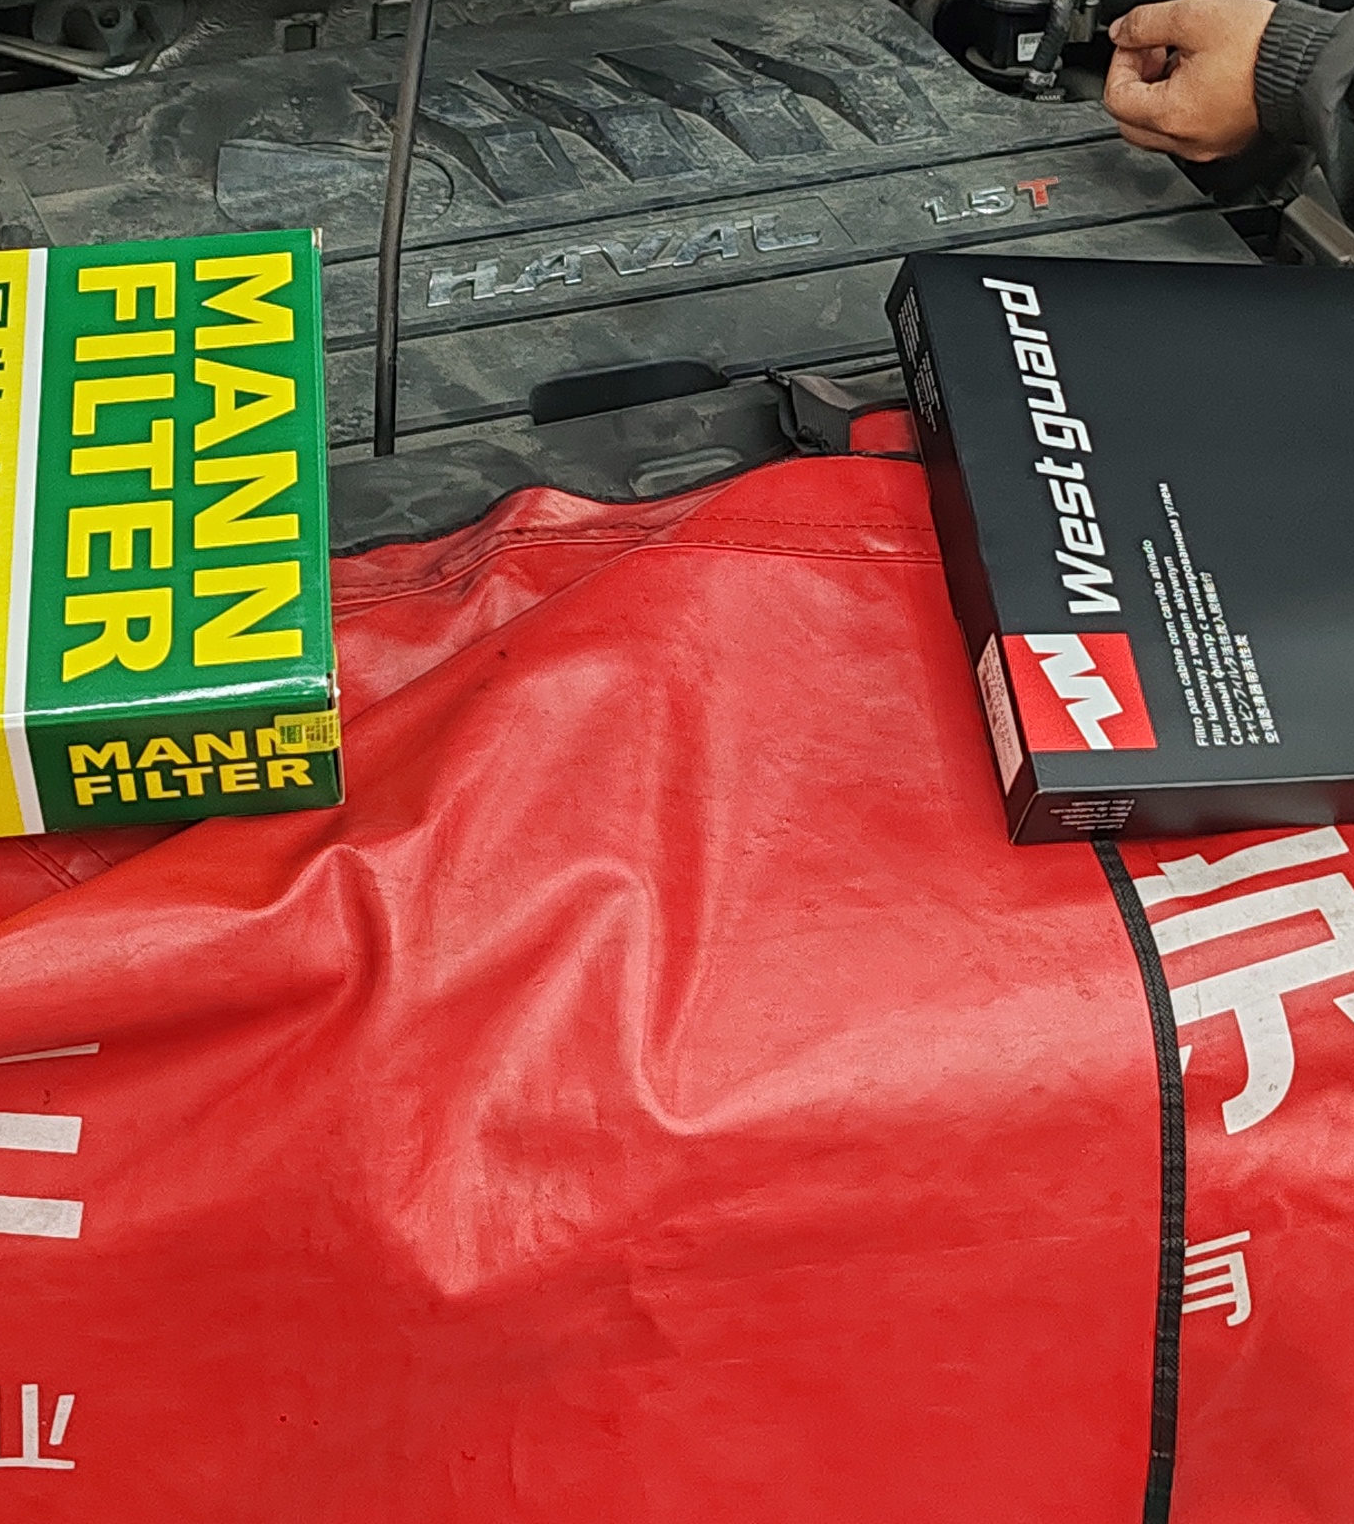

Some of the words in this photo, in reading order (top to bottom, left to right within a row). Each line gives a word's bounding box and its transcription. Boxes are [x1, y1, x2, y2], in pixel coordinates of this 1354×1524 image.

[427, 214, 822, 307] HAVAL
[62, 261, 176, 683] FILTER
[194, 251, 303, 667] MANN
[1158, 483, 1180, 518] углем
[1142, 539, 1162, 580] ativado
[1166, 621, 1180, 646] com
[1204, 631, 1226, 679] фильтр
[1173, 648, 1191, 687] cabine
[1183, 688, 1199, 716] para
[1199, 668, 1219, 721] kabinowy
[1220, 681, 1244, 745] Салонный
[1192, 717, 1209, 747] Filtro
[1210, 722, 1226, 746] Filtr
[74, 758, 313, 806] FILTER
